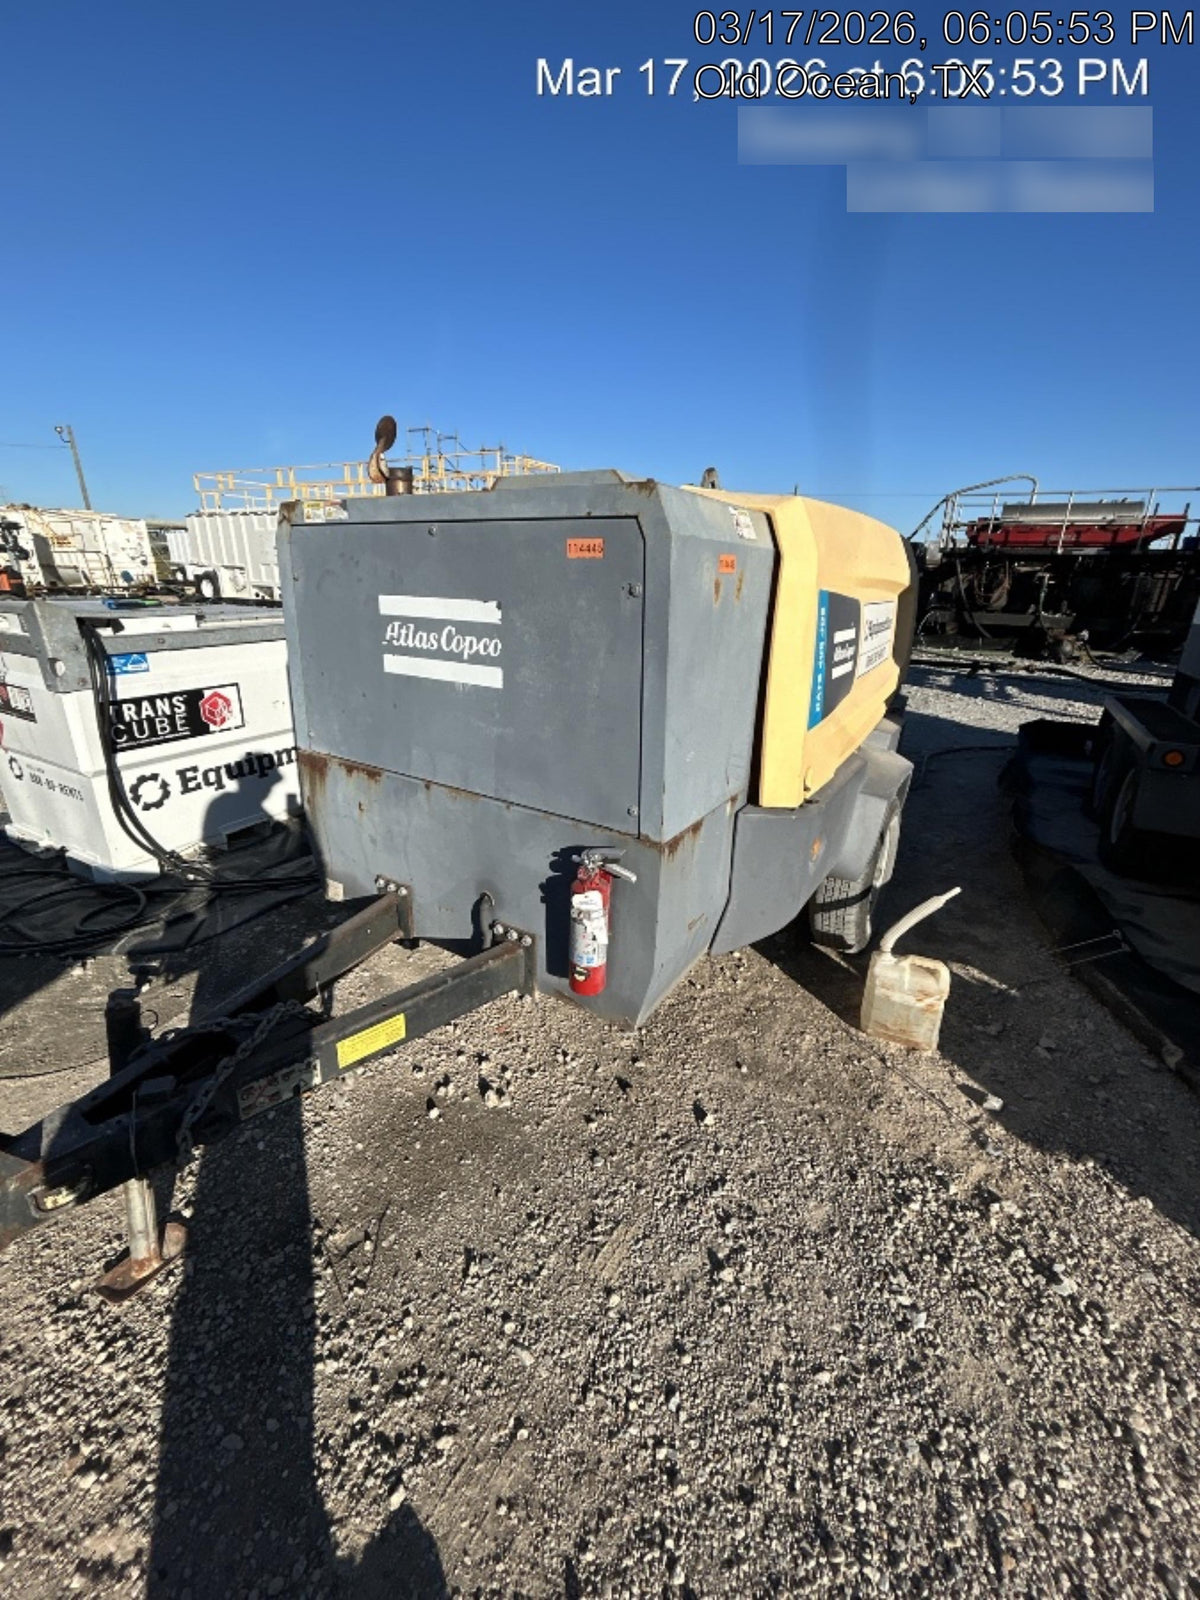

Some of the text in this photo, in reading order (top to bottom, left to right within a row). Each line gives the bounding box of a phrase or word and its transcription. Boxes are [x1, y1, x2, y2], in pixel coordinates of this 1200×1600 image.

[382, 621, 502, 660] Atlas Copco
[109, 695, 187, 722] TRANS
[111, 713, 191, 742] CUBE
